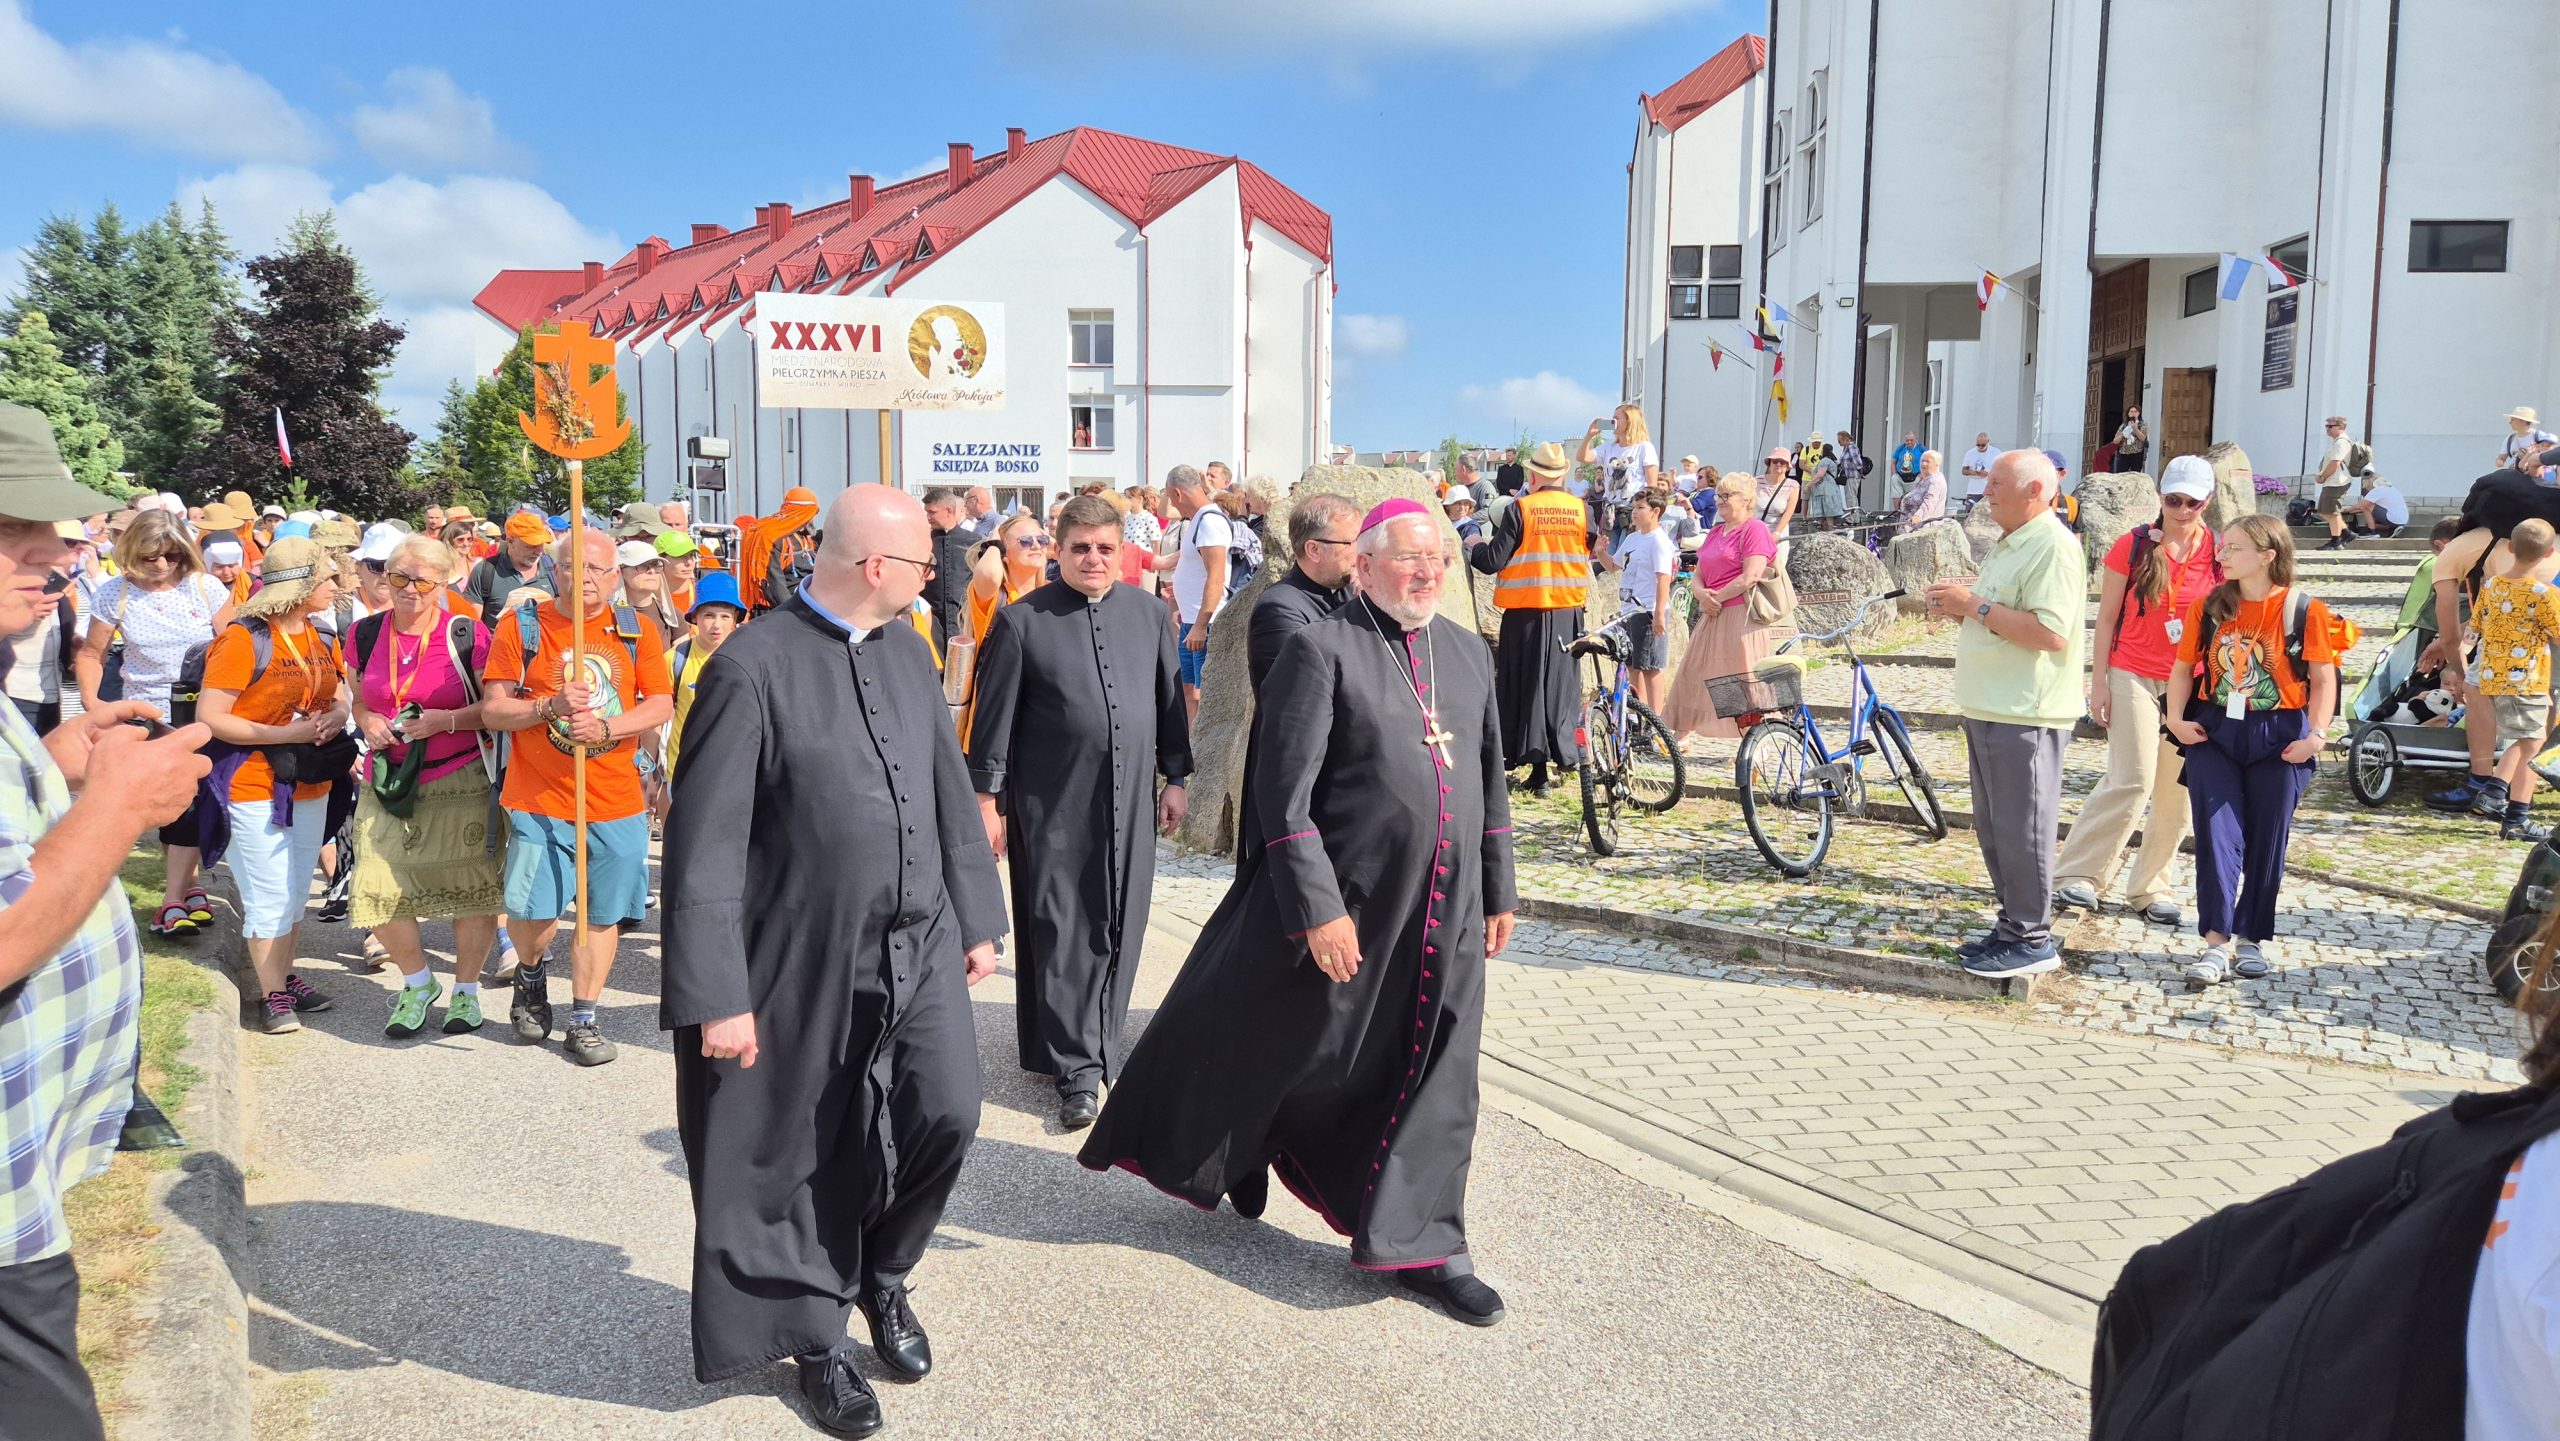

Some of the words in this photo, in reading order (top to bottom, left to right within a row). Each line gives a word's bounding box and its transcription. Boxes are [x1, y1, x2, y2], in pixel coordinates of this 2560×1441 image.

[770, 321, 881, 352] XXXVI
[771, 355, 884, 368] MIĘDZYNARODOWA
[772, 368, 848, 379] PIELGRZYMKA
[850, 370, 887, 380] PIESZA
[900, 389, 948, 402] Królowa
[951, 388, 993, 406] Pokoju
[933, 443, 1041, 456] SALEZJANIE
[933, 460, 989, 474] KSIĘDZA
[996, 460, 1040, 473] BOSKO
[1530, 507, 1580, 517] KIEROWANIE
[1537, 516, 1575, 526] RUCHEM
[1948, 577, 1978, 585] SZYMO
